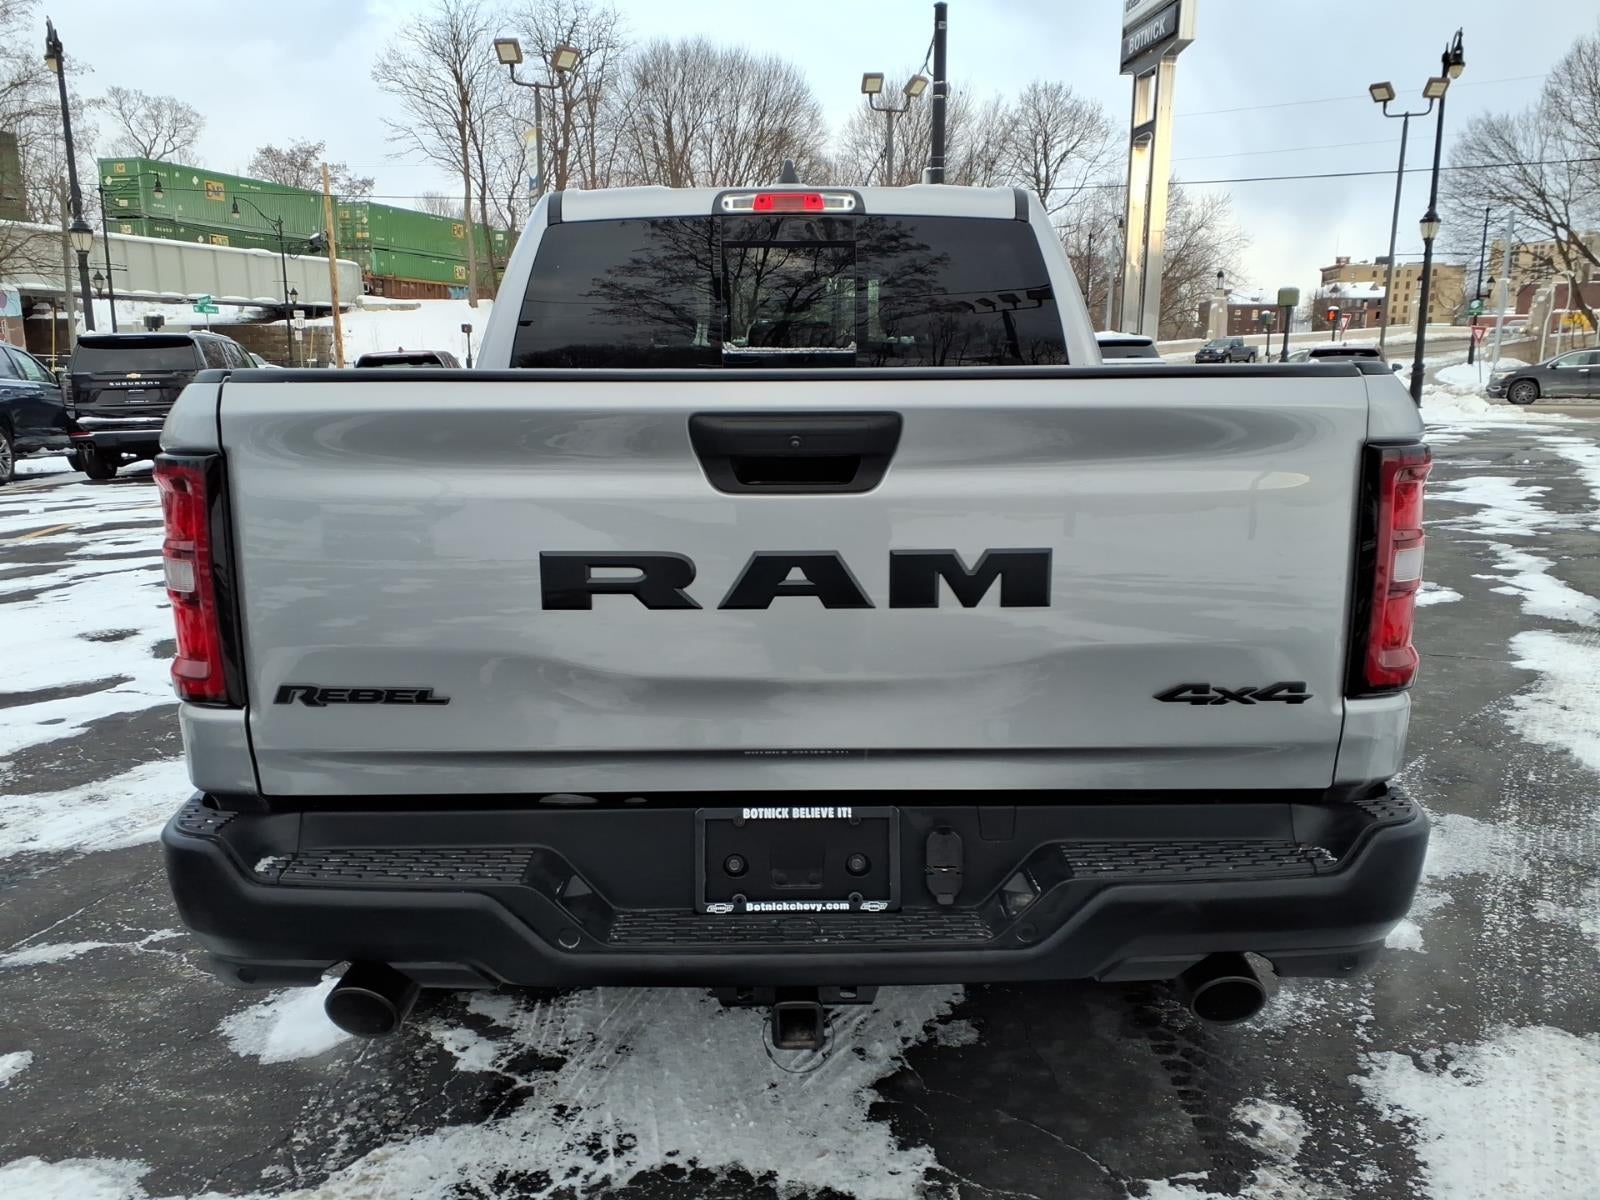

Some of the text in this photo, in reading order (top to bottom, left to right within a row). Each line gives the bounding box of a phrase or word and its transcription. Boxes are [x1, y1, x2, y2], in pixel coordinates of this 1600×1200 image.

[1128, 17, 1167, 55] BOTNICK
[539, 547, 1053, 611] RAM
[273, 683, 451, 707] REBEL
[742, 806, 852, 819] BOTNICK BELIEVE IT!
[746, 902, 850, 912] Botnickchevy.com
